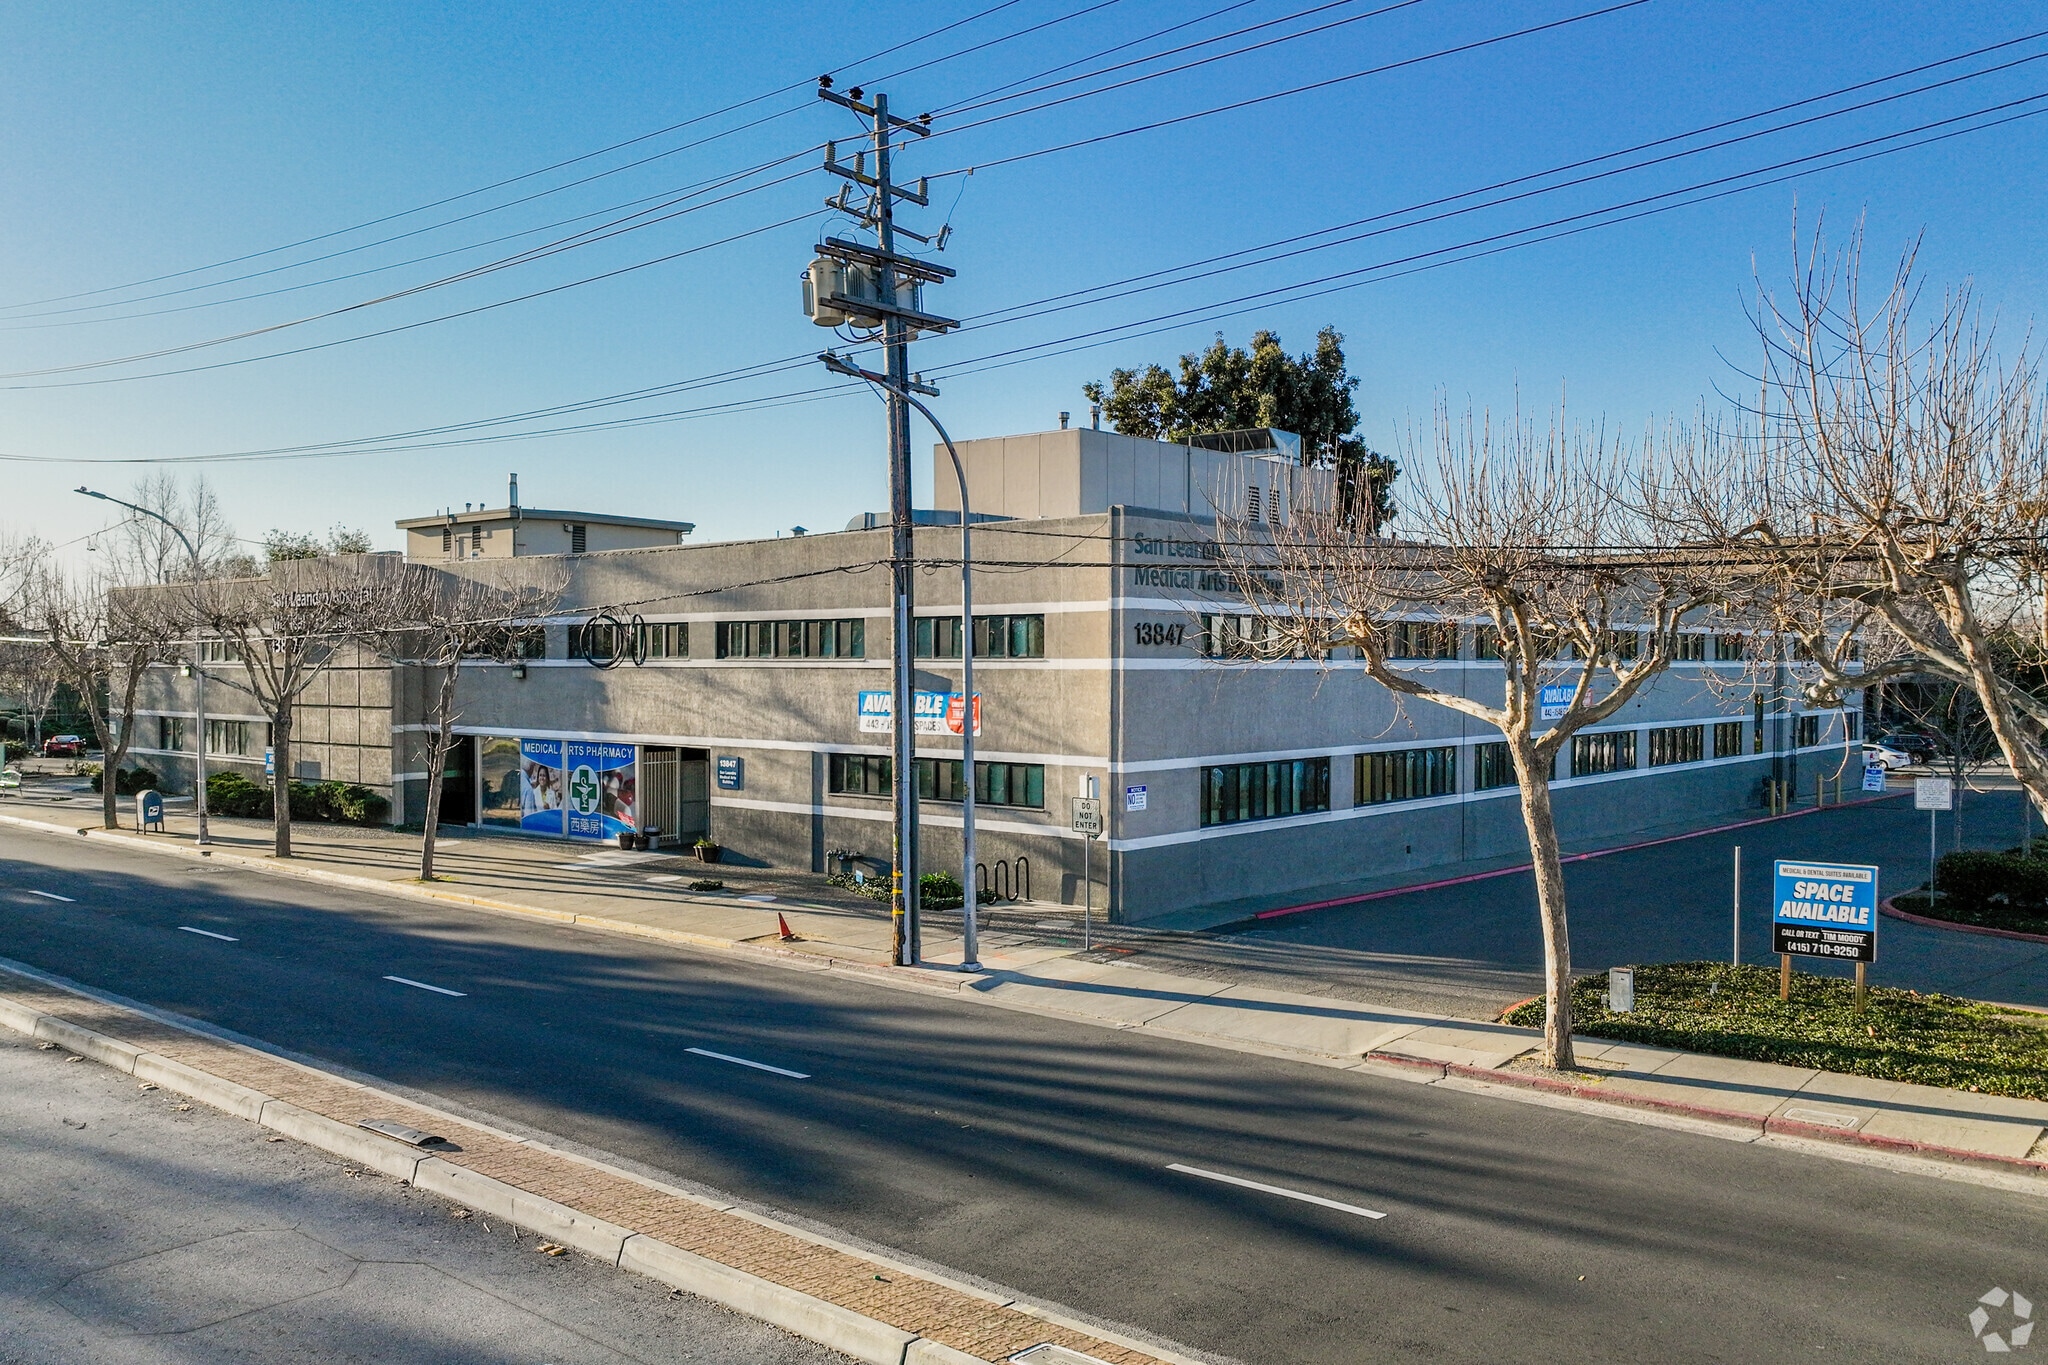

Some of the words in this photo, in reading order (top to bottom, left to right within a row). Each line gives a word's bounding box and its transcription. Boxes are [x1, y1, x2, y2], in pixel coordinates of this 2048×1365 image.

[1134, 532, 1164, 556] San
[1134, 567, 1195, 589] Medical
[1198, 570, 1227, 592] Arts
[1134, 622, 1186, 645] 13847
[862, 694, 944, 714] AVABLE
[914, 719, 941, 732] SPACES
[524, 742, 558, 755] MEDICAL
[586, 746, 633, 759] PHARMACY
[720, 760, 736, 768] 13847
[1081, 802, 1091, 810] DO
[1127, 794, 1136, 805] NO
[1079, 812, 1093, 820] NOT
[570, 817, 600, 835] 西藥房
[1075, 820, 1097, 830] ENTER
[1782, 867, 1802, 875] MEDICAL
[1807, 869, 1824, 877] DENTAL
[1825, 870, 1841, 878] SUITES
[1842, 871, 1868, 880] AVAILABLE
[1793, 881, 1855, 903] SPACE
[1778, 900, 1870, 925] AVAILABLE
[1781, 928, 1796, 937] CALL
[1796, 930, 1805, 938] OR
[1804, 931, 1820, 939] TEXT
[1822, 932, 1837, 941] TIM
[1837, 934, 1864, 944] MOODY
[1787, 941, 1810, 953] (415)
[1812, 943, 1859, 958] 710-9250
